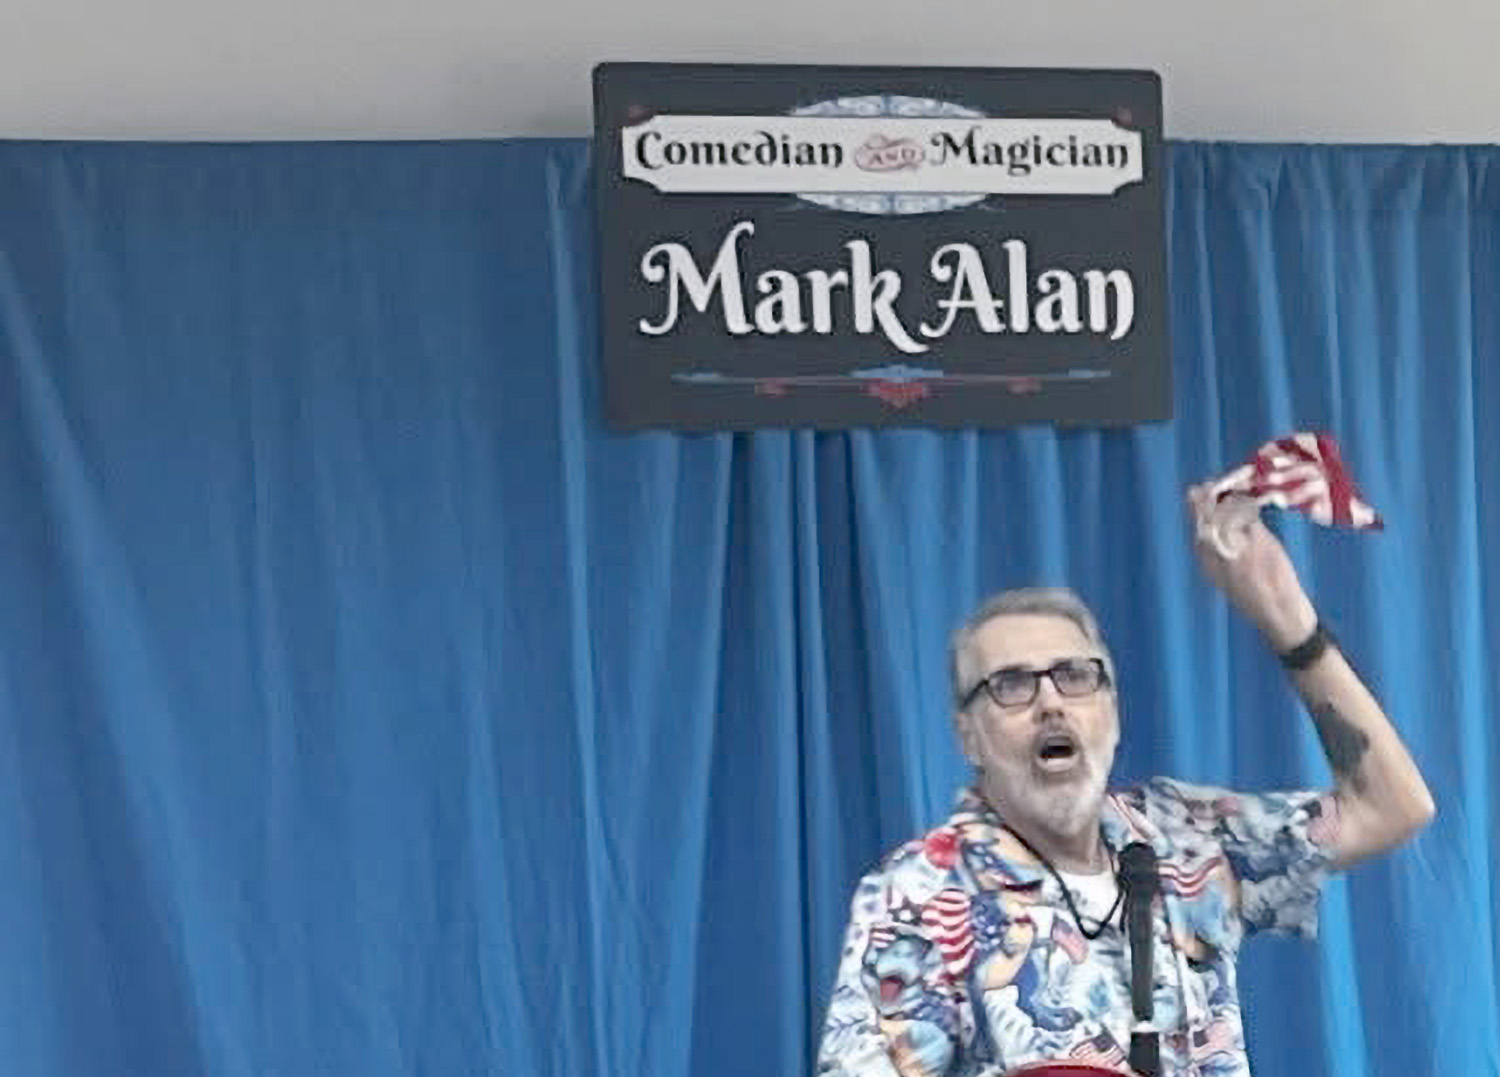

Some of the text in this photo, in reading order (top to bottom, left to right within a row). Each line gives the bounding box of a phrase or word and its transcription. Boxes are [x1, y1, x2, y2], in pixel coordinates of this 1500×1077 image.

[635, 130, 843, 170] Comedian
[930, 126, 1129, 175] Magician
[638, 221, 1136, 354] Mark Alan
